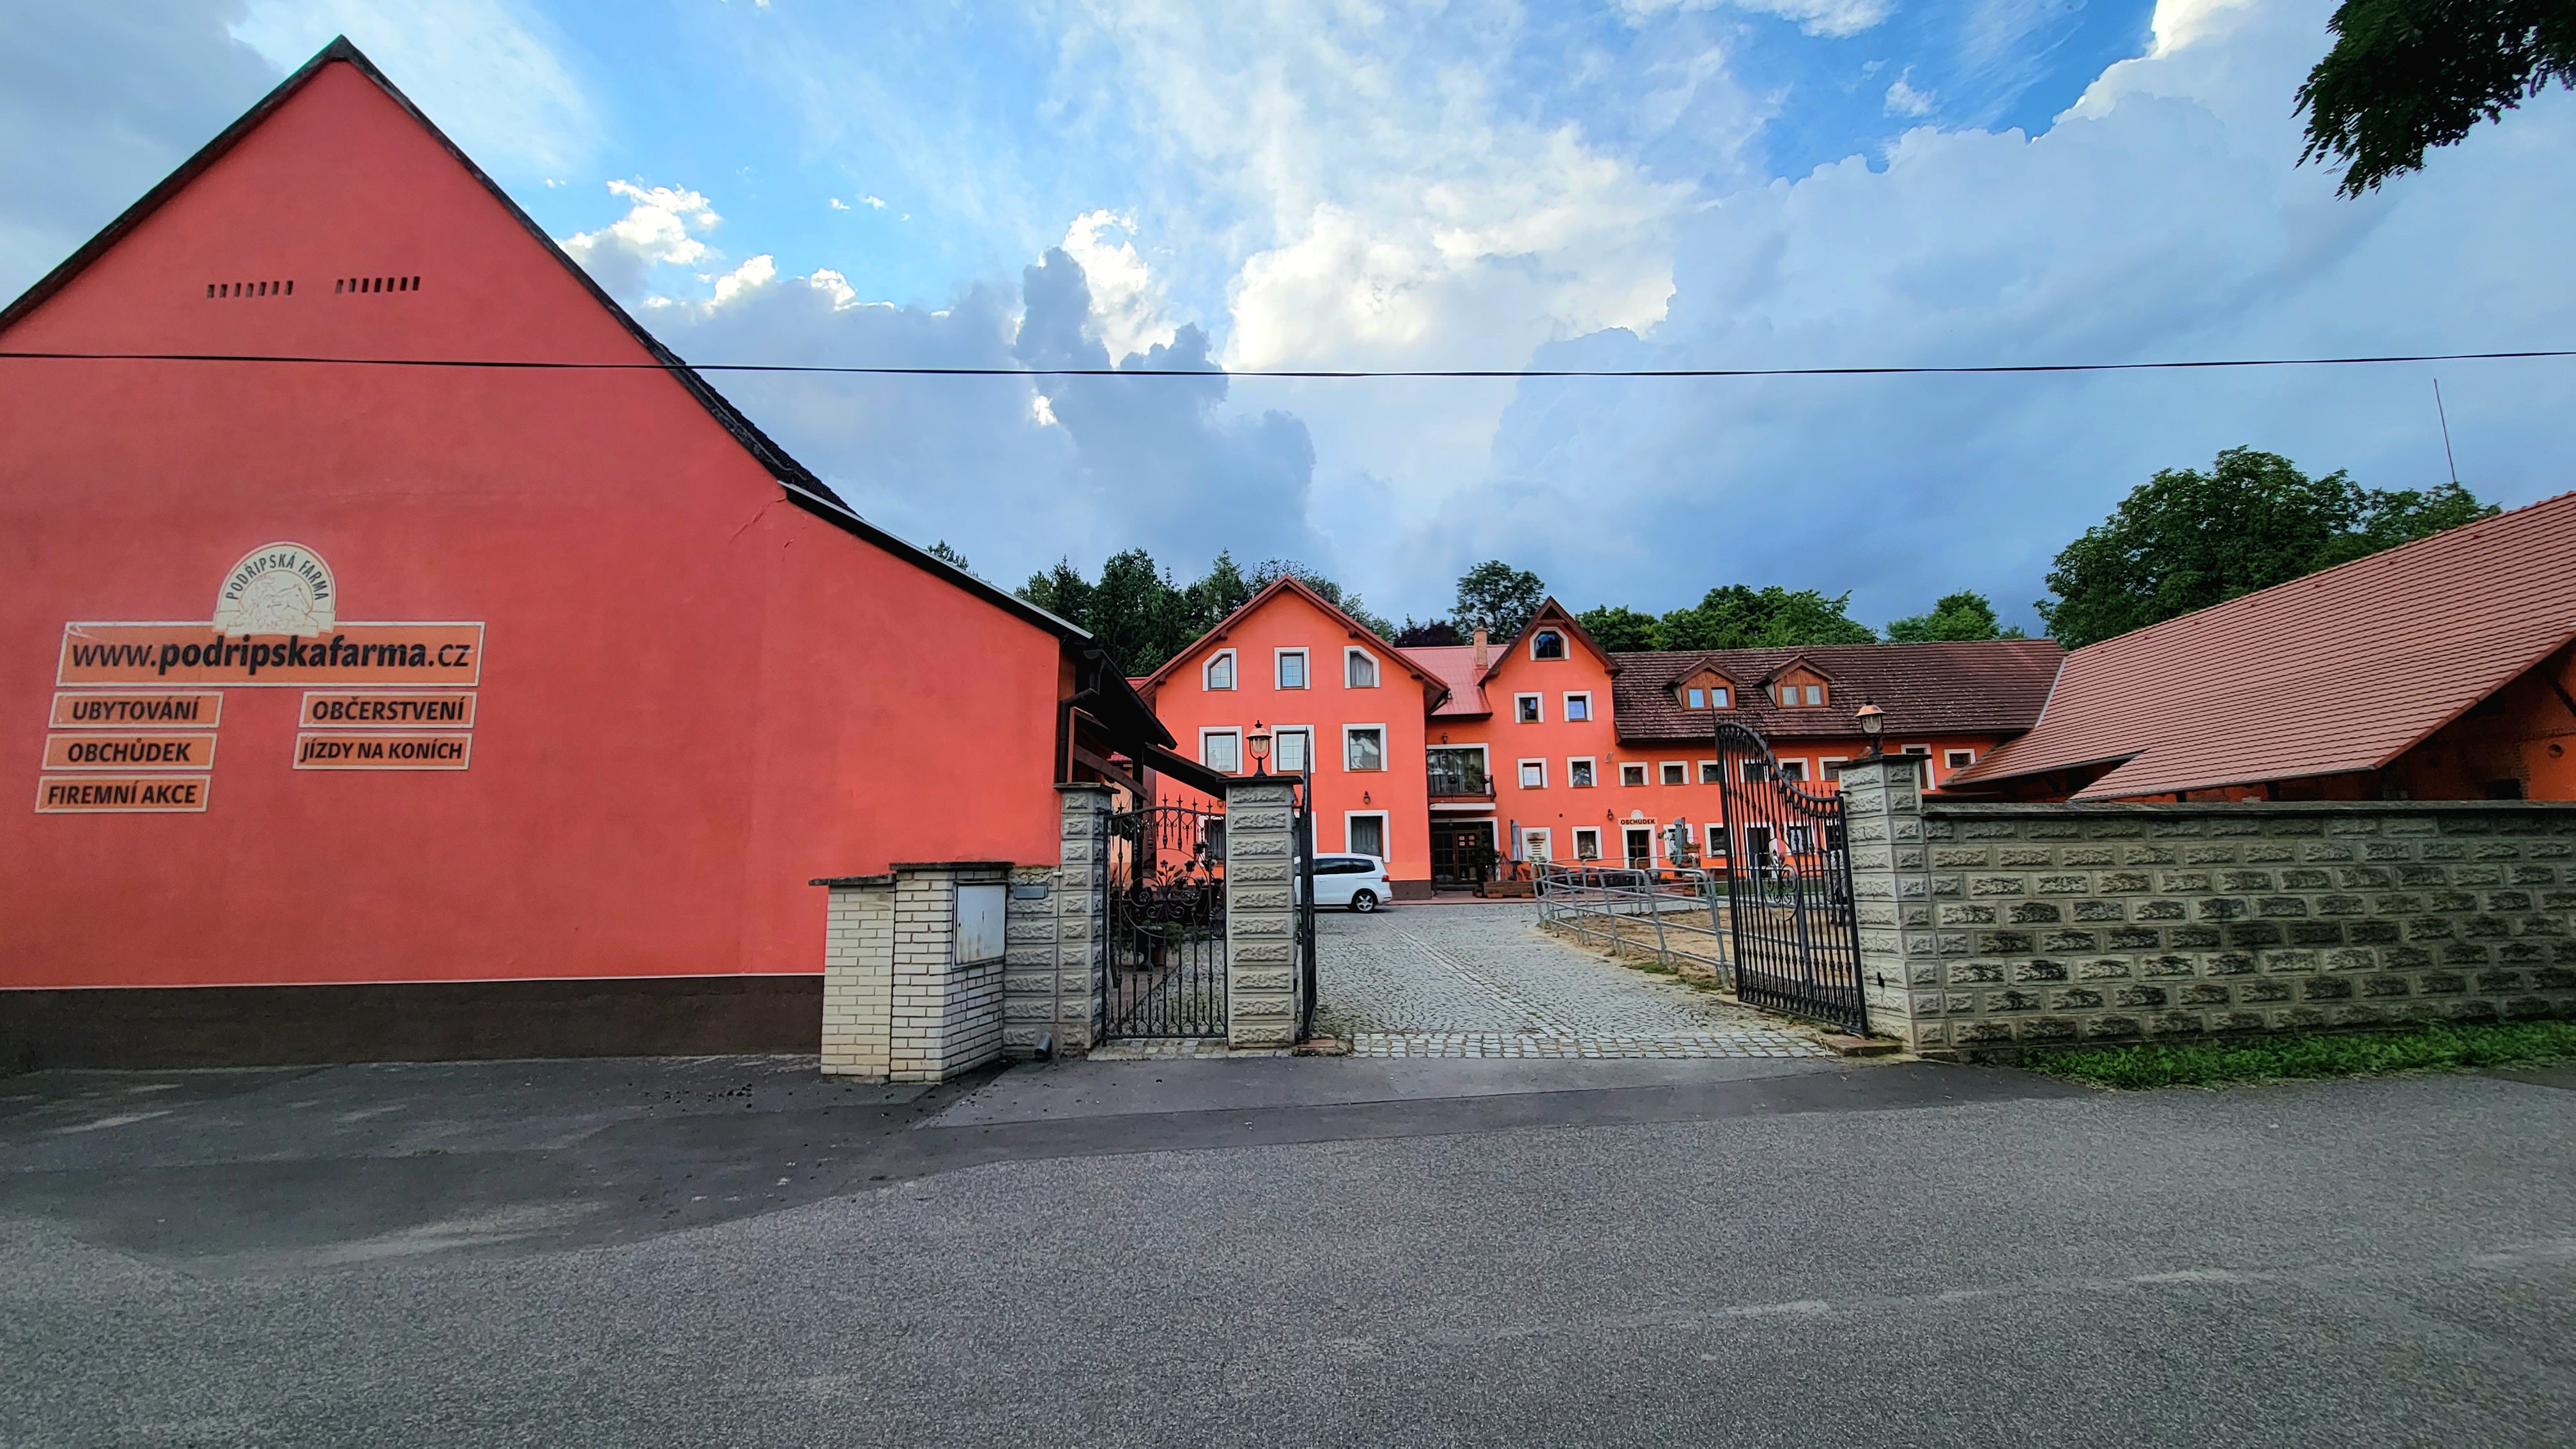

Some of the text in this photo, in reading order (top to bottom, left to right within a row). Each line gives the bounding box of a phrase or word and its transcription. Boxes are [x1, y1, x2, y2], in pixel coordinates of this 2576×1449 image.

[226, 552, 329, 600] PODŘIPSKÁ FARMA
[72, 635, 470, 675] www.podripskafarma.cz
[73, 696, 201, 720] UBYTOVÁNÍ
[312, 696, 466, 720] OBČERSTVENÍ
[68, 738, 192, 762] OBCHŮDEK
[300, 739, 463, 762] JÍZDY NA KONÍCH
[47, 780, 197, 805] FIREMNÍ AKCE
